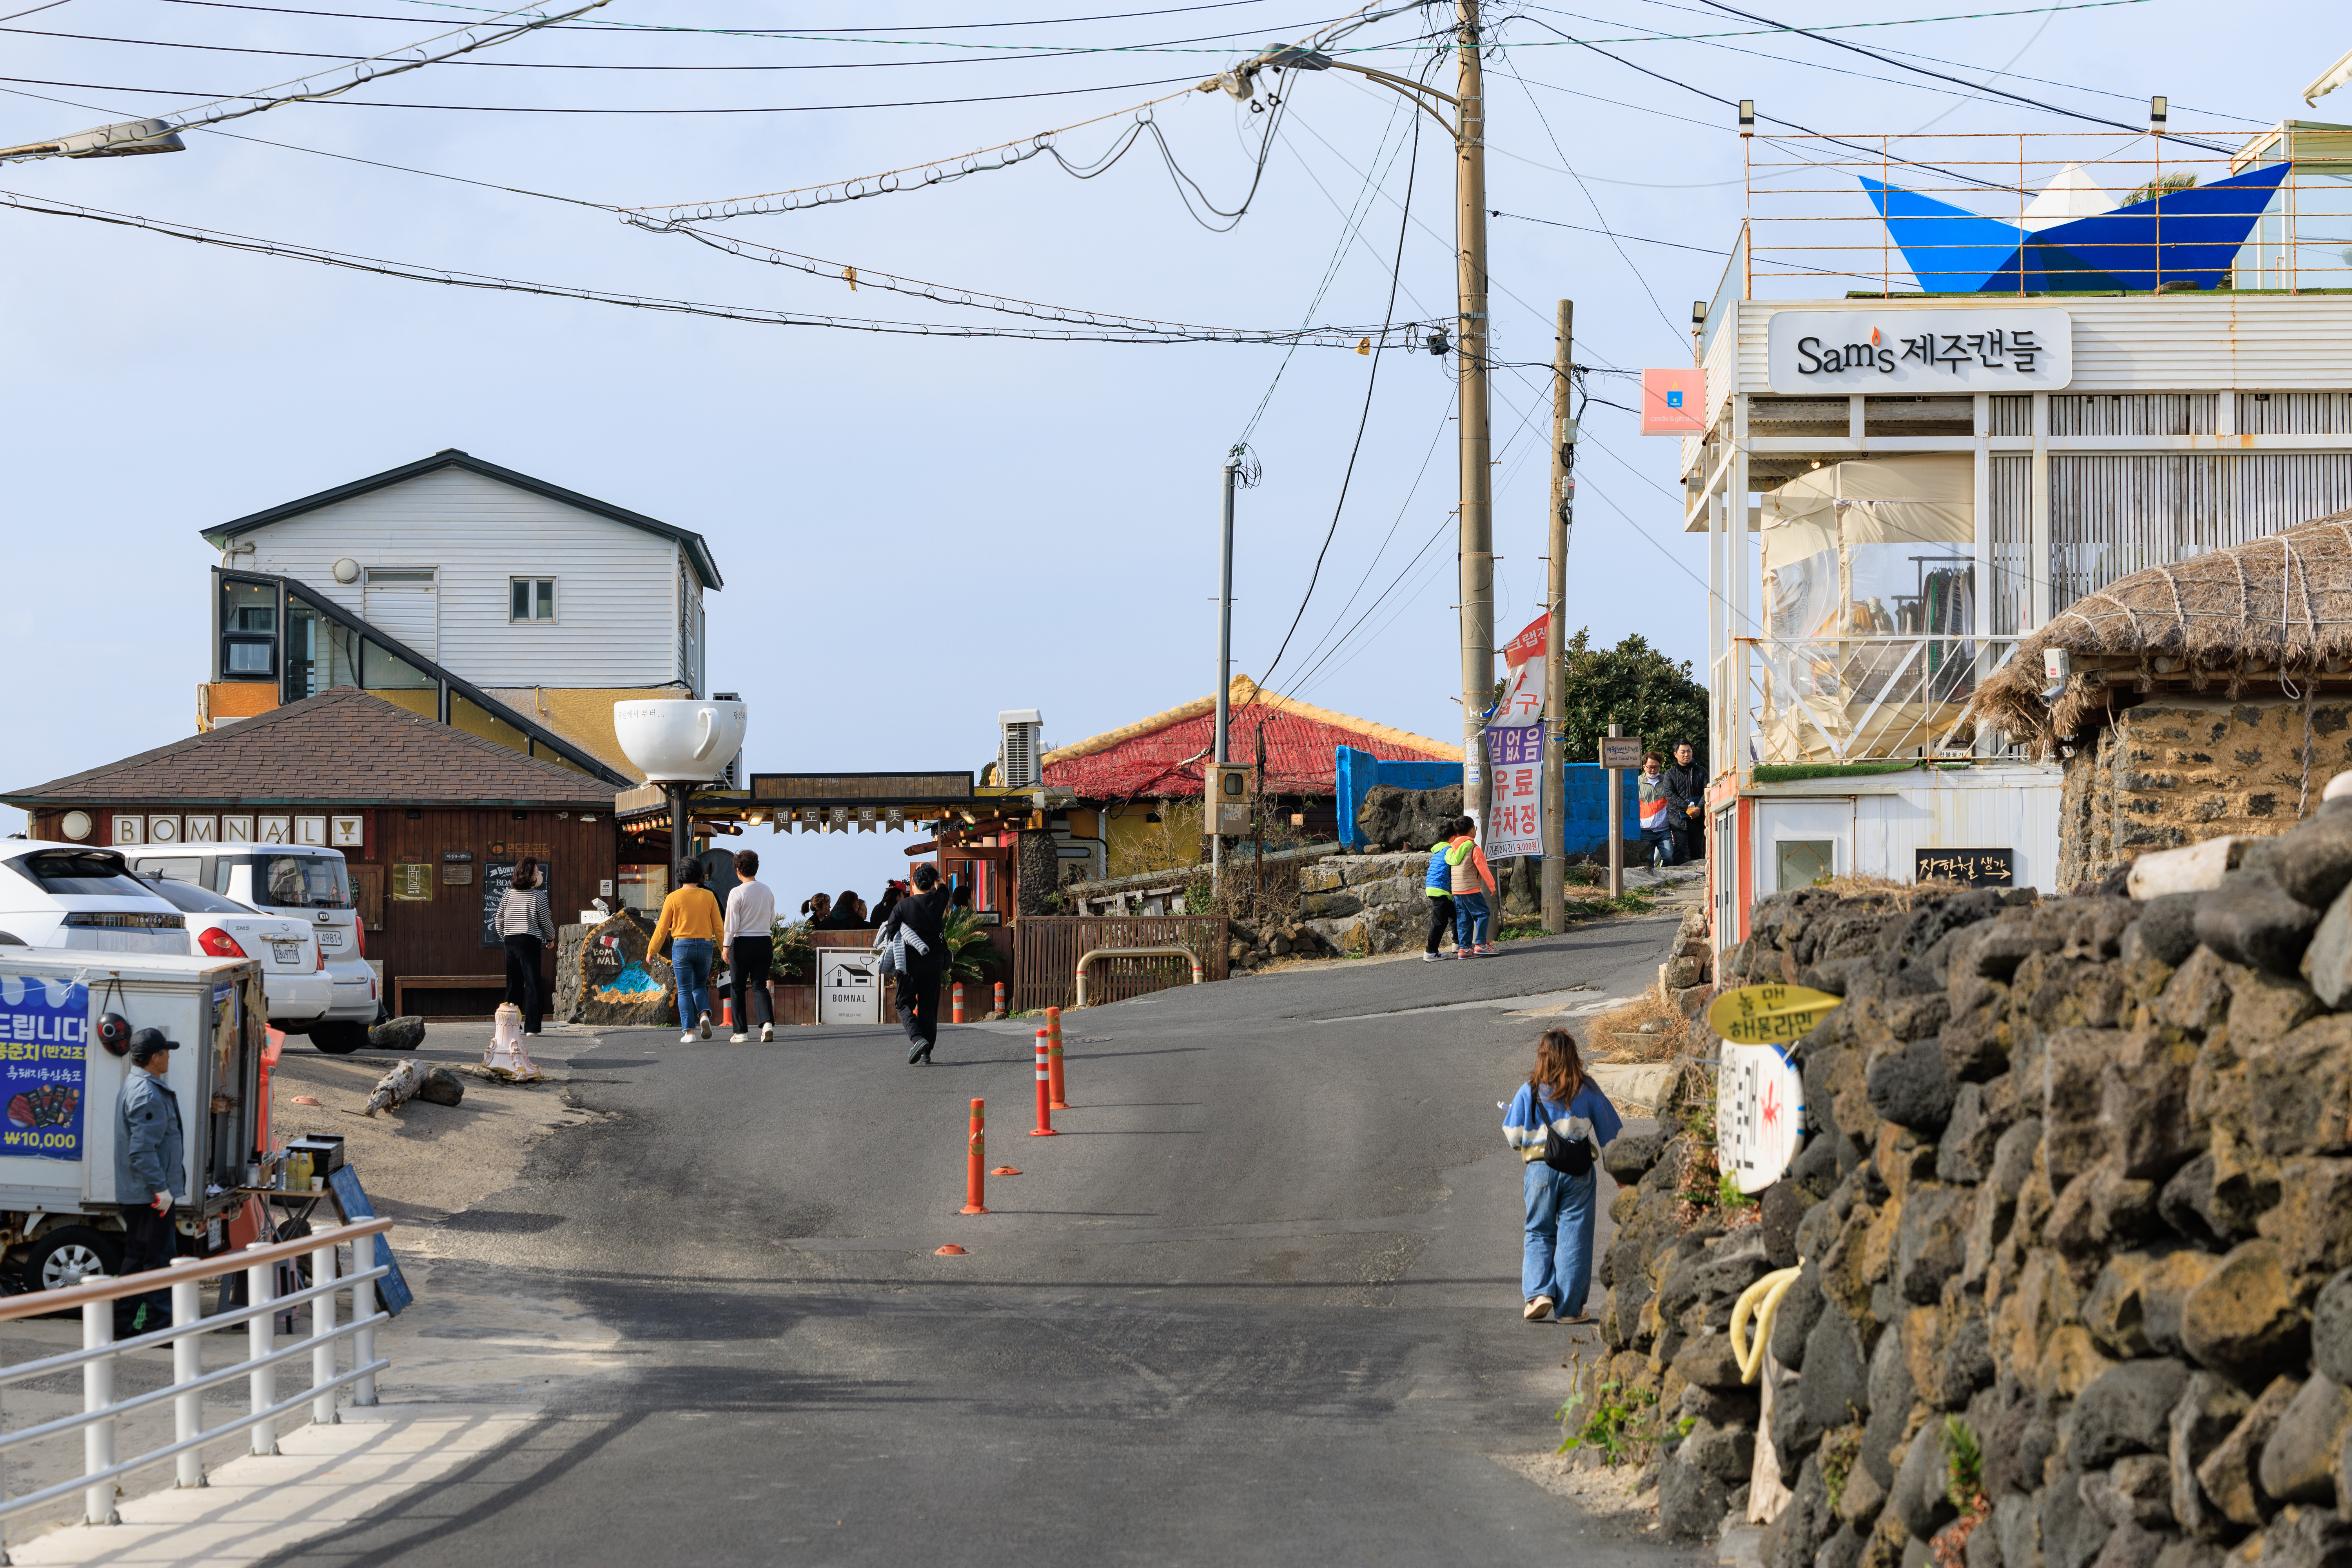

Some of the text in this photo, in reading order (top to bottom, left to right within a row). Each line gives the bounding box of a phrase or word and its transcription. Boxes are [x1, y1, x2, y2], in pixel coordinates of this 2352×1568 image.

[1798, 326, 2042, 374] Sam's 제주캔들
[1490, 728, 1540, 763] 길없음
[1494, 768, 1534, 801] 유료
[122, 819, 315, 842] BOMNAL
[1492, 803, 1536, 838] 주차장
[497, 866, 515, 879] BOMN
[1981, 857, 2006, 870] 생가
[485, 894, 502, 902] CAPPUCCIN
[597, 956, 618, 965] NAL
[833, 994, 866, 1002] BOMNAL
[1729, 1010, 1814, 1041] 해물라면
[4, 1131, 76, 1149] ₩10,000
